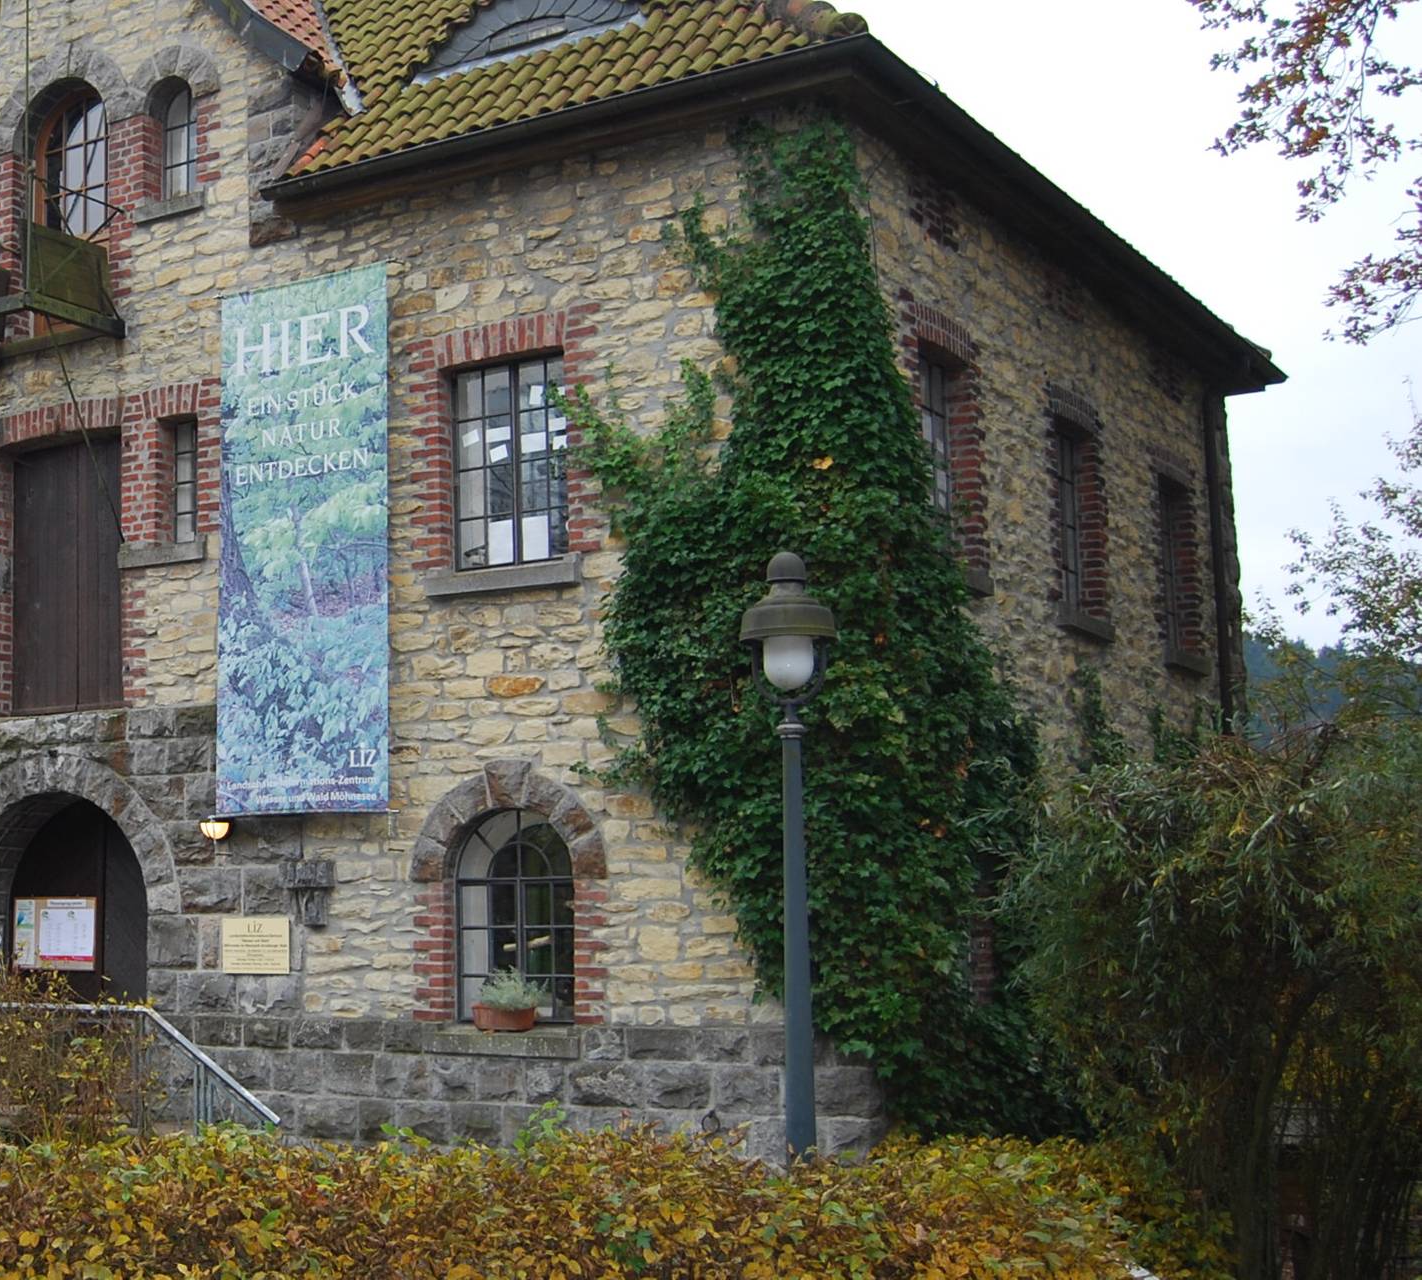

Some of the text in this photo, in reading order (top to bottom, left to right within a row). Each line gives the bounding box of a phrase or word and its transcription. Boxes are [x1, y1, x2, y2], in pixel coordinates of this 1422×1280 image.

[235, 304, 375, 376] HIER
[248, 379, 358, 416] EIN STÜCK
[262, 418, 342, 448] NATUR
[236, 448, 369, 486] ENTDECKEN
